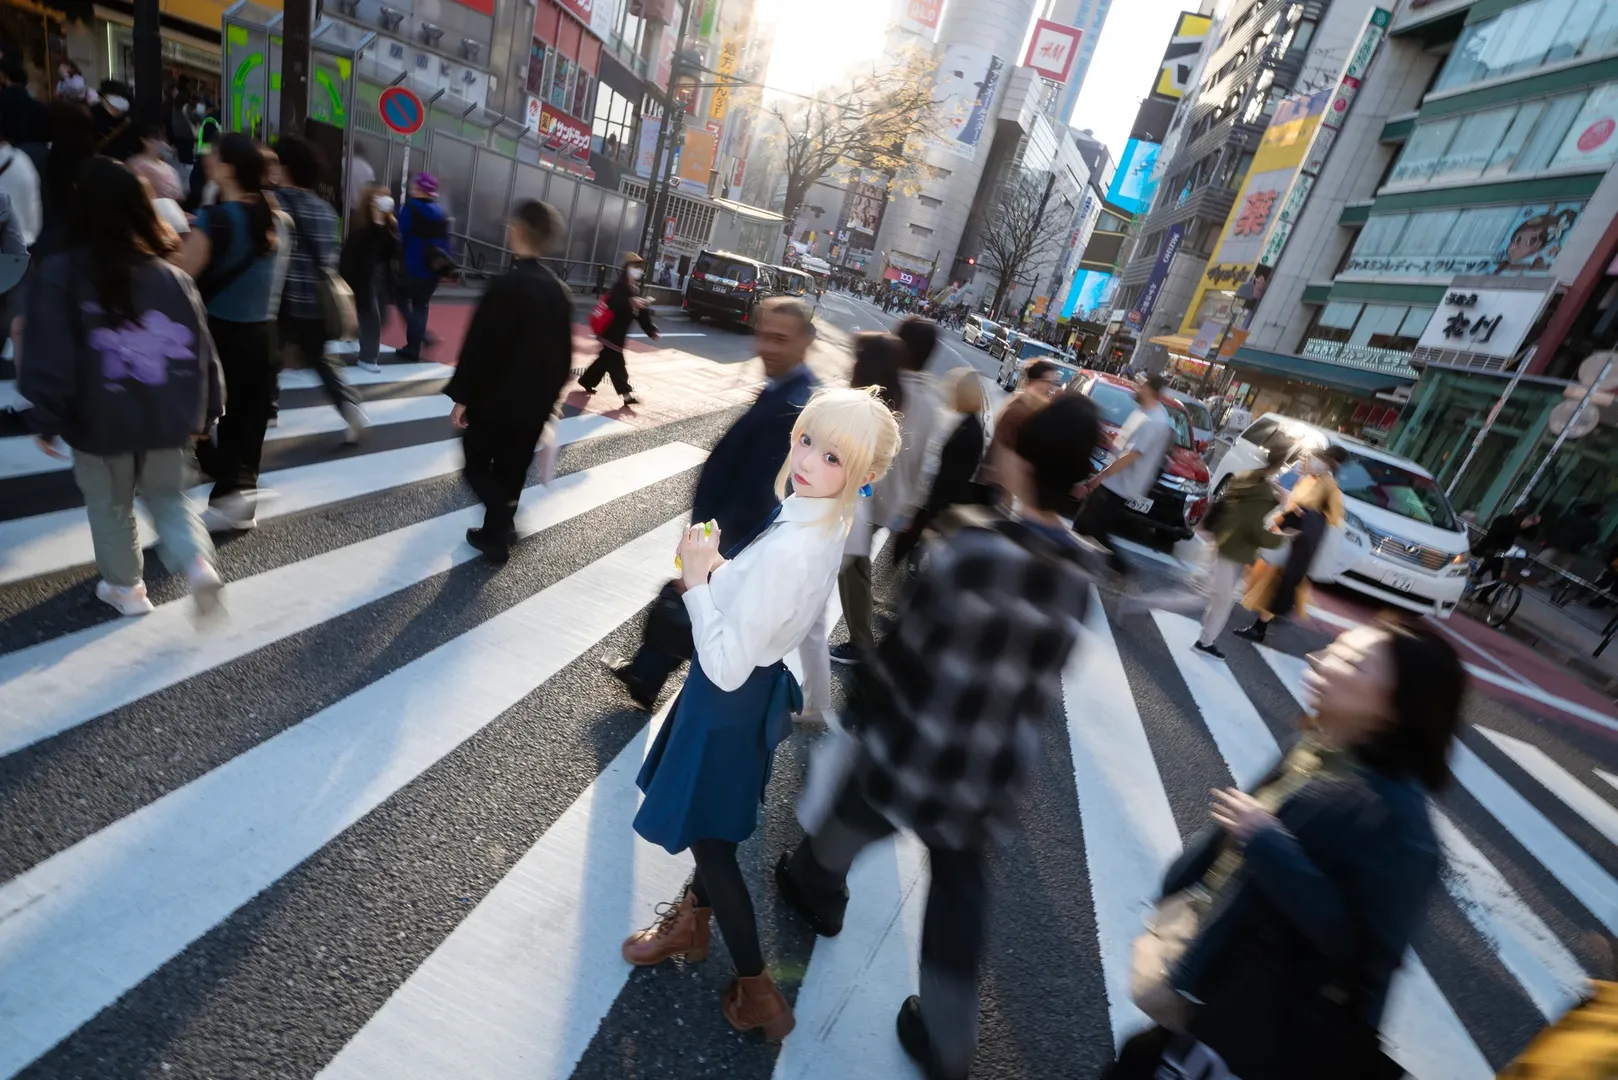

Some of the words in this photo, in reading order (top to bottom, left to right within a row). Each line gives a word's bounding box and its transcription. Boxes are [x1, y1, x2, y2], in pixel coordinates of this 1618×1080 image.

[1040, 41, 1066, 62] H&M
[555, 119, 592, 150] サンドラッグ
[899, 271, 913, 285] 109
